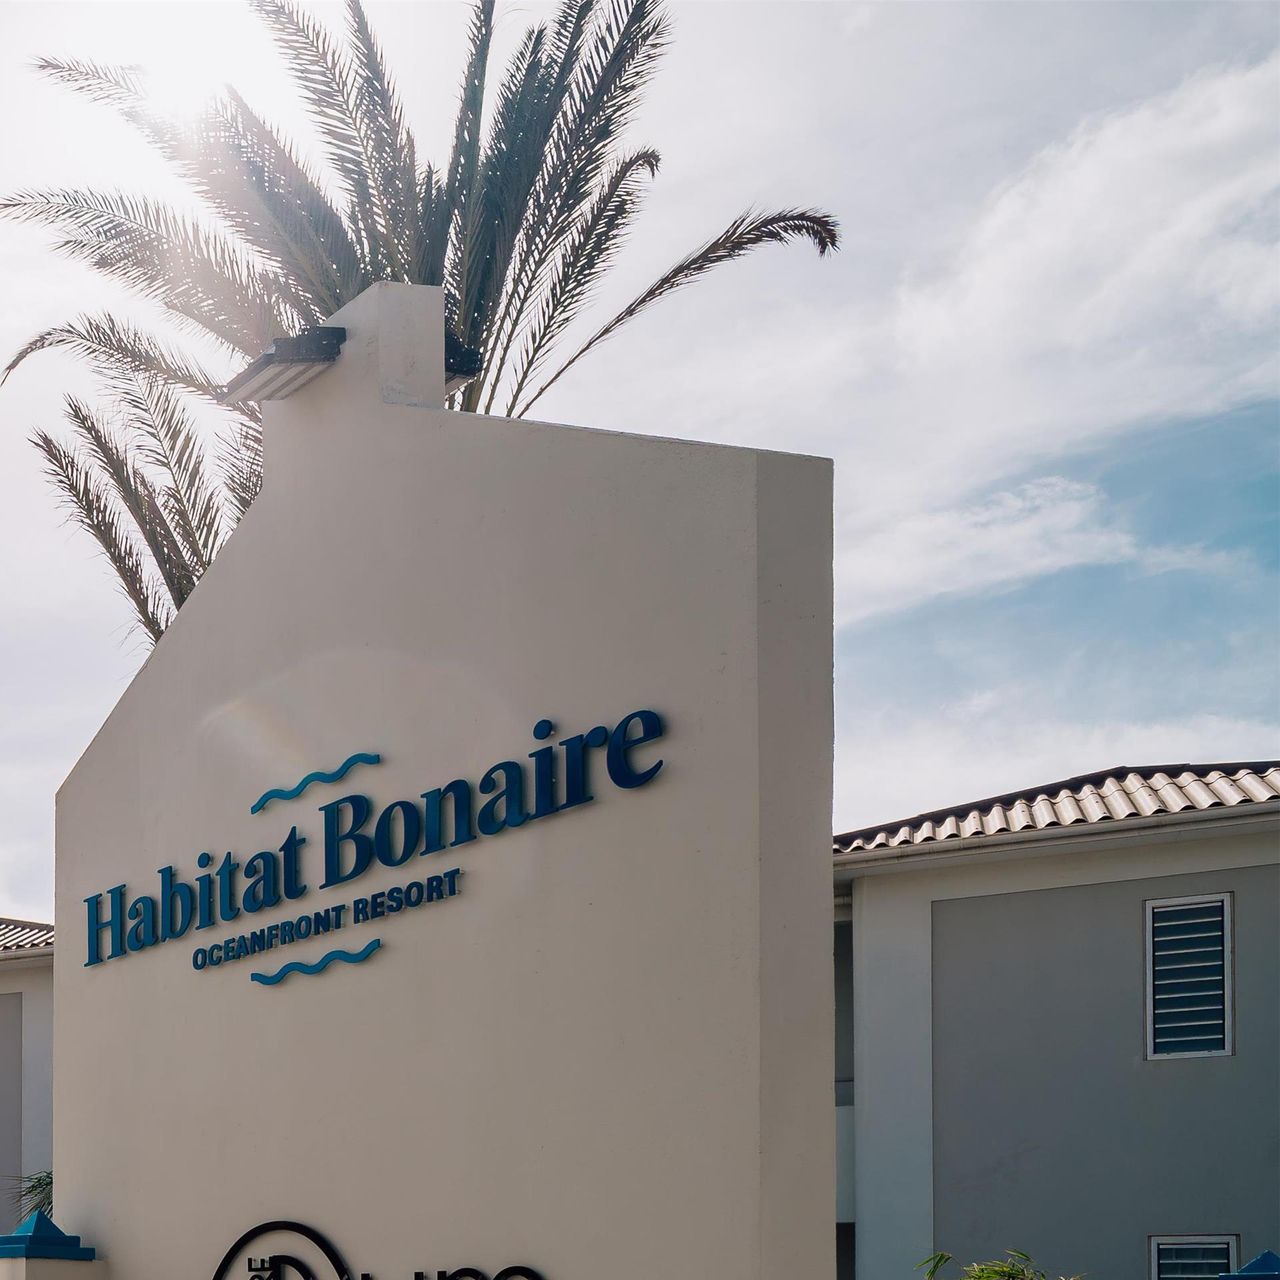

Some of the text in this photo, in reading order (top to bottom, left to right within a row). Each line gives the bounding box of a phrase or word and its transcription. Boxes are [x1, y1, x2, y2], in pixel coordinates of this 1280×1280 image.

[83, 710, 664, 967] Habitat Bonaire
[192, 867, 461, 970] OCEANFRONT RESORT
